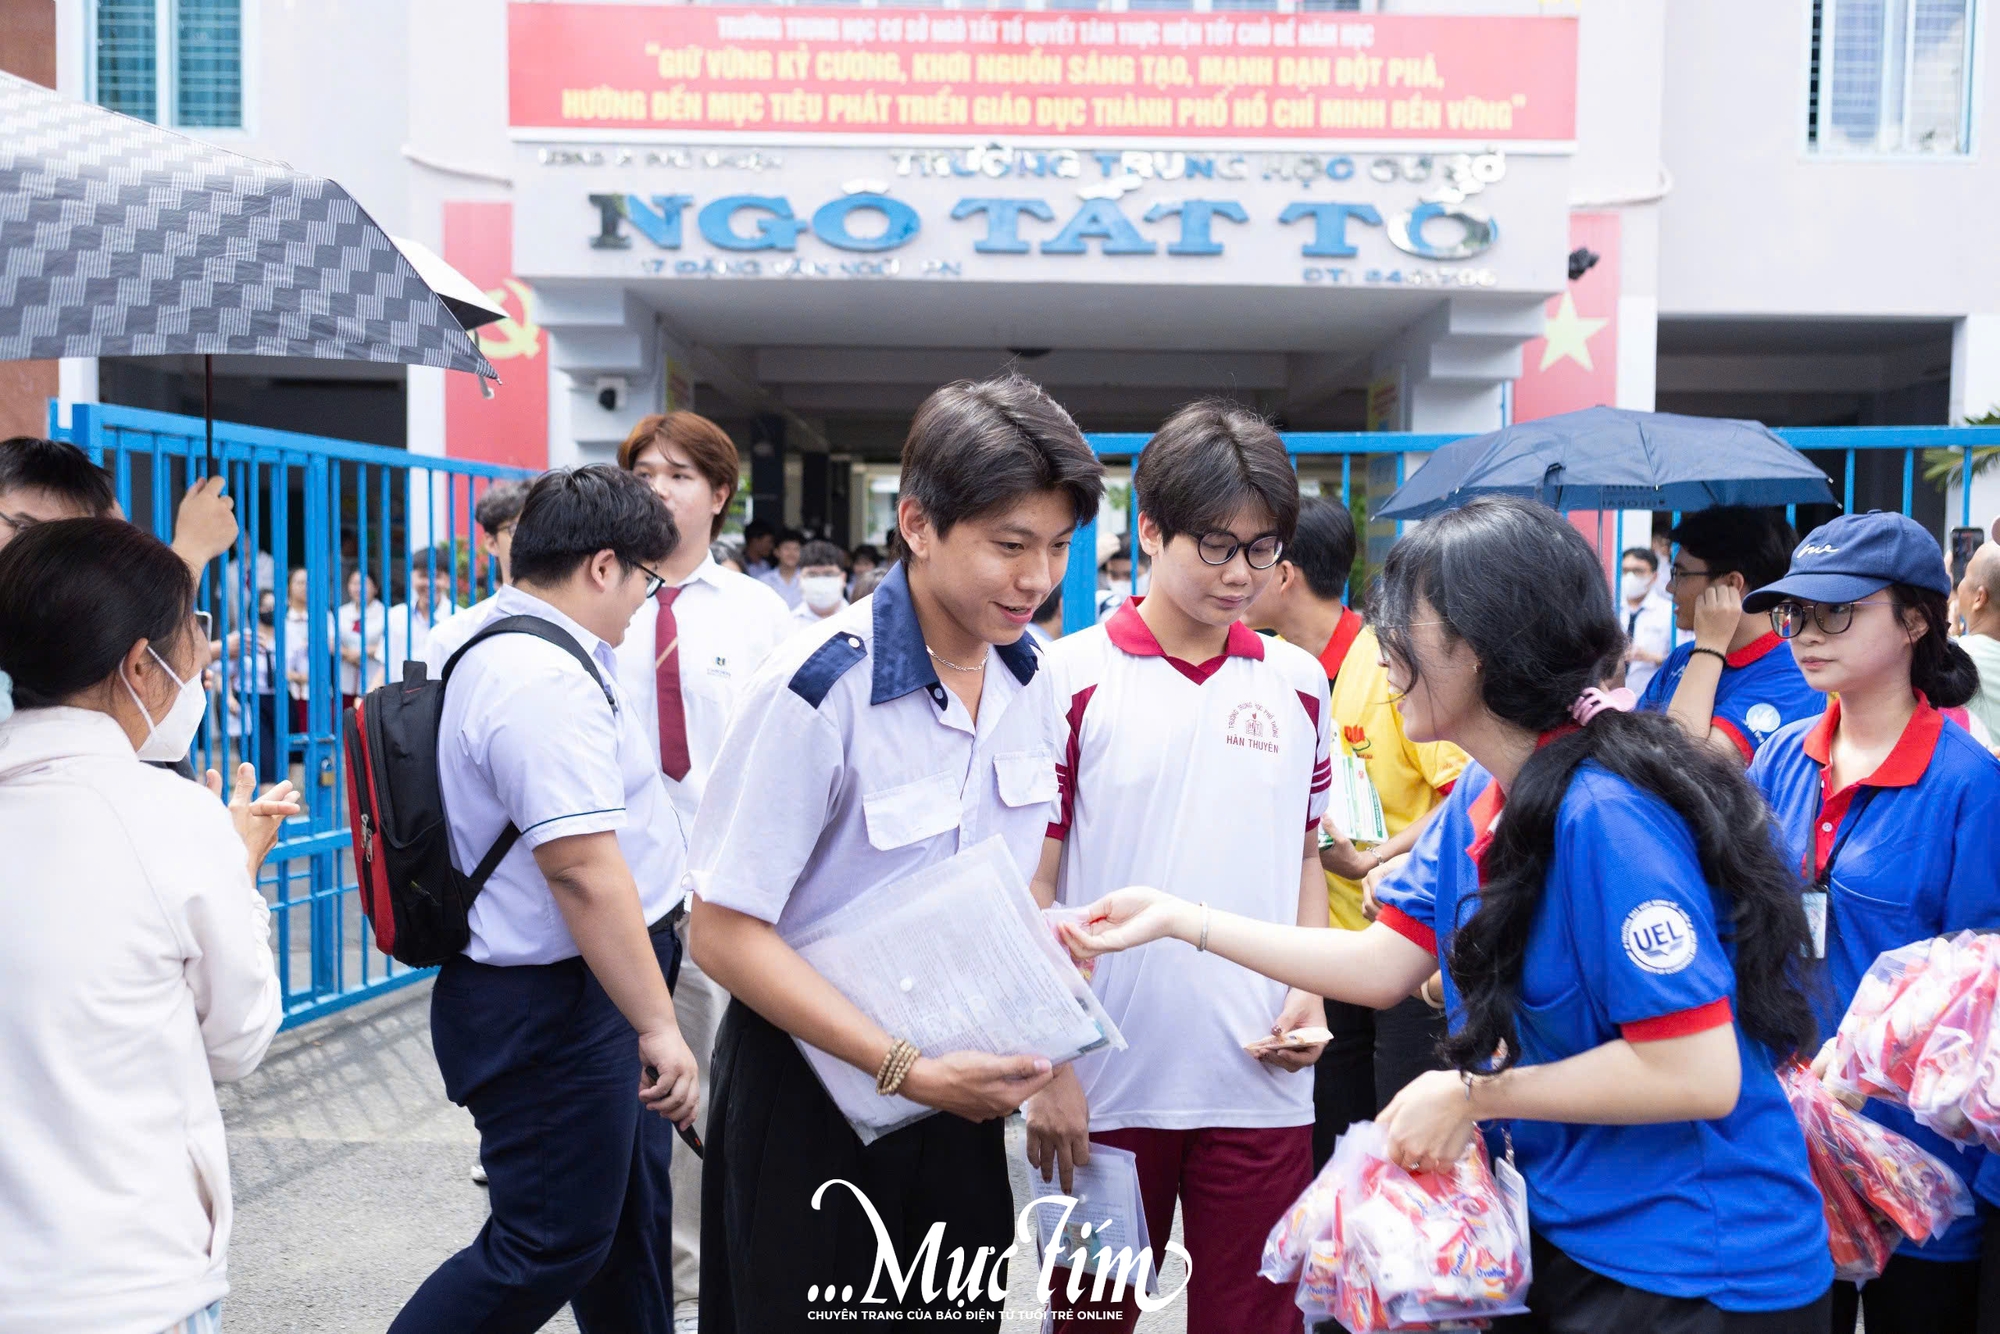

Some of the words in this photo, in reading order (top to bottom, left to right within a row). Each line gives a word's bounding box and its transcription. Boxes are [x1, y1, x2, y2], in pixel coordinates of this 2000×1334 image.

[707, 46, 772, 81] VỮNG
[778, 42, 810, 81] KỶ
[816, 47, 906, 85] CƯƠNG,
[912, 49, 971, 83] KHƠI
[977, 46, 1060, 84] NGUỒN
[1068, 51, 1135, 85] SÁNG
[1141, 55, 1193, 88] TẠO,
[1200, 57, 1273, 92] MẠNH
[1279, 56, 1330, 91] DẠN
[1336, 54, 1382, 92] ĐỘT
[1387, 52, 1444, 90] PHÁ,
[562, 84, 646, 120] HƯỚNG
[652, 83, 701, 120] ĐẾN
[708, 91, 763, 127] MỤC
[770, 87, 821, 122] TIÊU
[828, 88, 889, 124] PHÁT
[894, 86, 968, 125] TRIỂN
[973, 91, 1029, 126] GIÁO
[1036, 97, 1086, 132] DỤC
[1092, 92, 1172, 128] THÀNH
[1178, 87, 1228, 128] PHỐ
[1234, 89, 1267, 129] HỒ
[1273, 93, 1314, 129] CHÍ
[1320, 98, 1385, 129] MINH
[1392, 92, 1441, 130] BỀN
[1094, 150, 1249, 181] TRUNG
[1262, 153, 1355, 189] HỌC
[588, 178, 921, 253] NGÔ
[950, 172, 1249, 257] TẤT
[1278, 182, 1498, 260] TỐ
[1226, 734, 1245, 746] HÀN
[1248, 738, 1279, 754] THUYÊN
[1633, 920, 1684, 952] UEL
